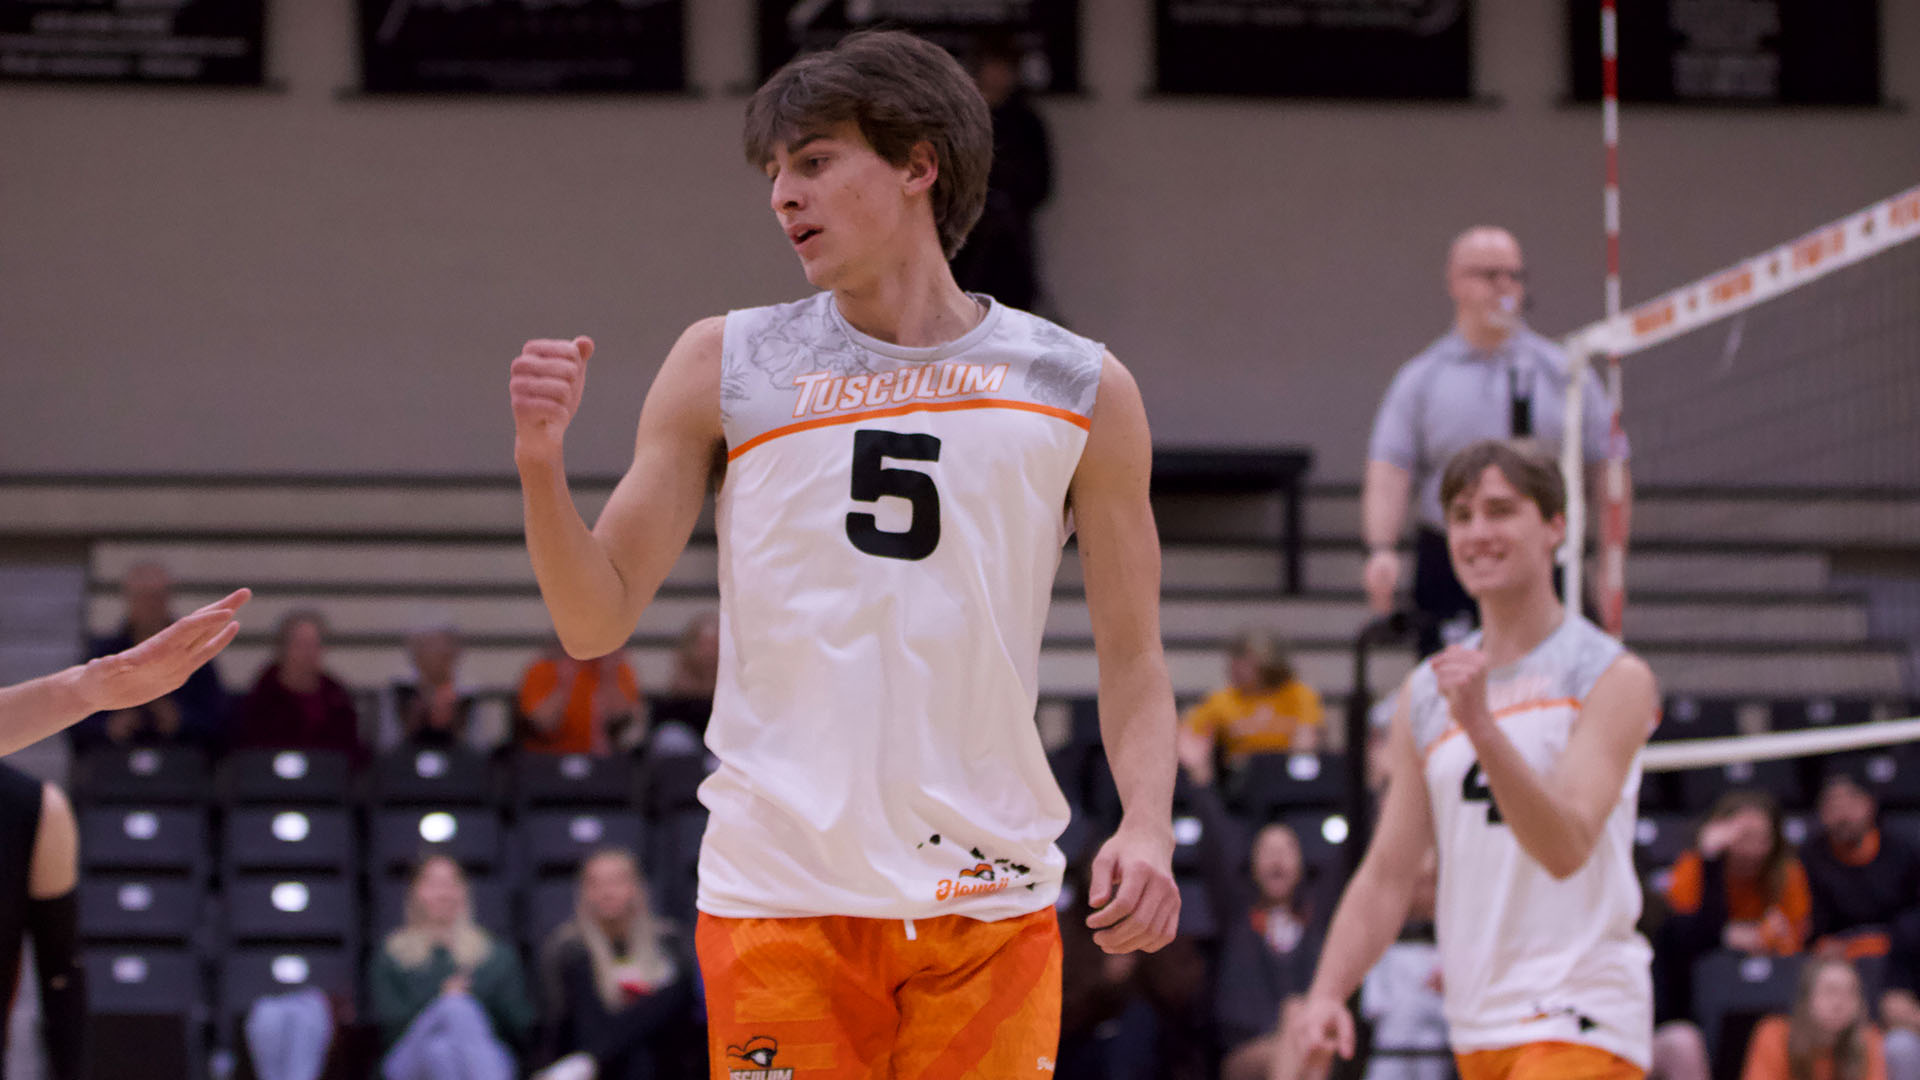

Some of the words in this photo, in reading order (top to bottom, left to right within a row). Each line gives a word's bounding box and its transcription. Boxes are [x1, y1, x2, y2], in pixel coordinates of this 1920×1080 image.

[792, 363, 1010, 418] TUSCULUM
[845, 429, 942, 561] 5
[935, 878, 1010, 902] Hawaii
